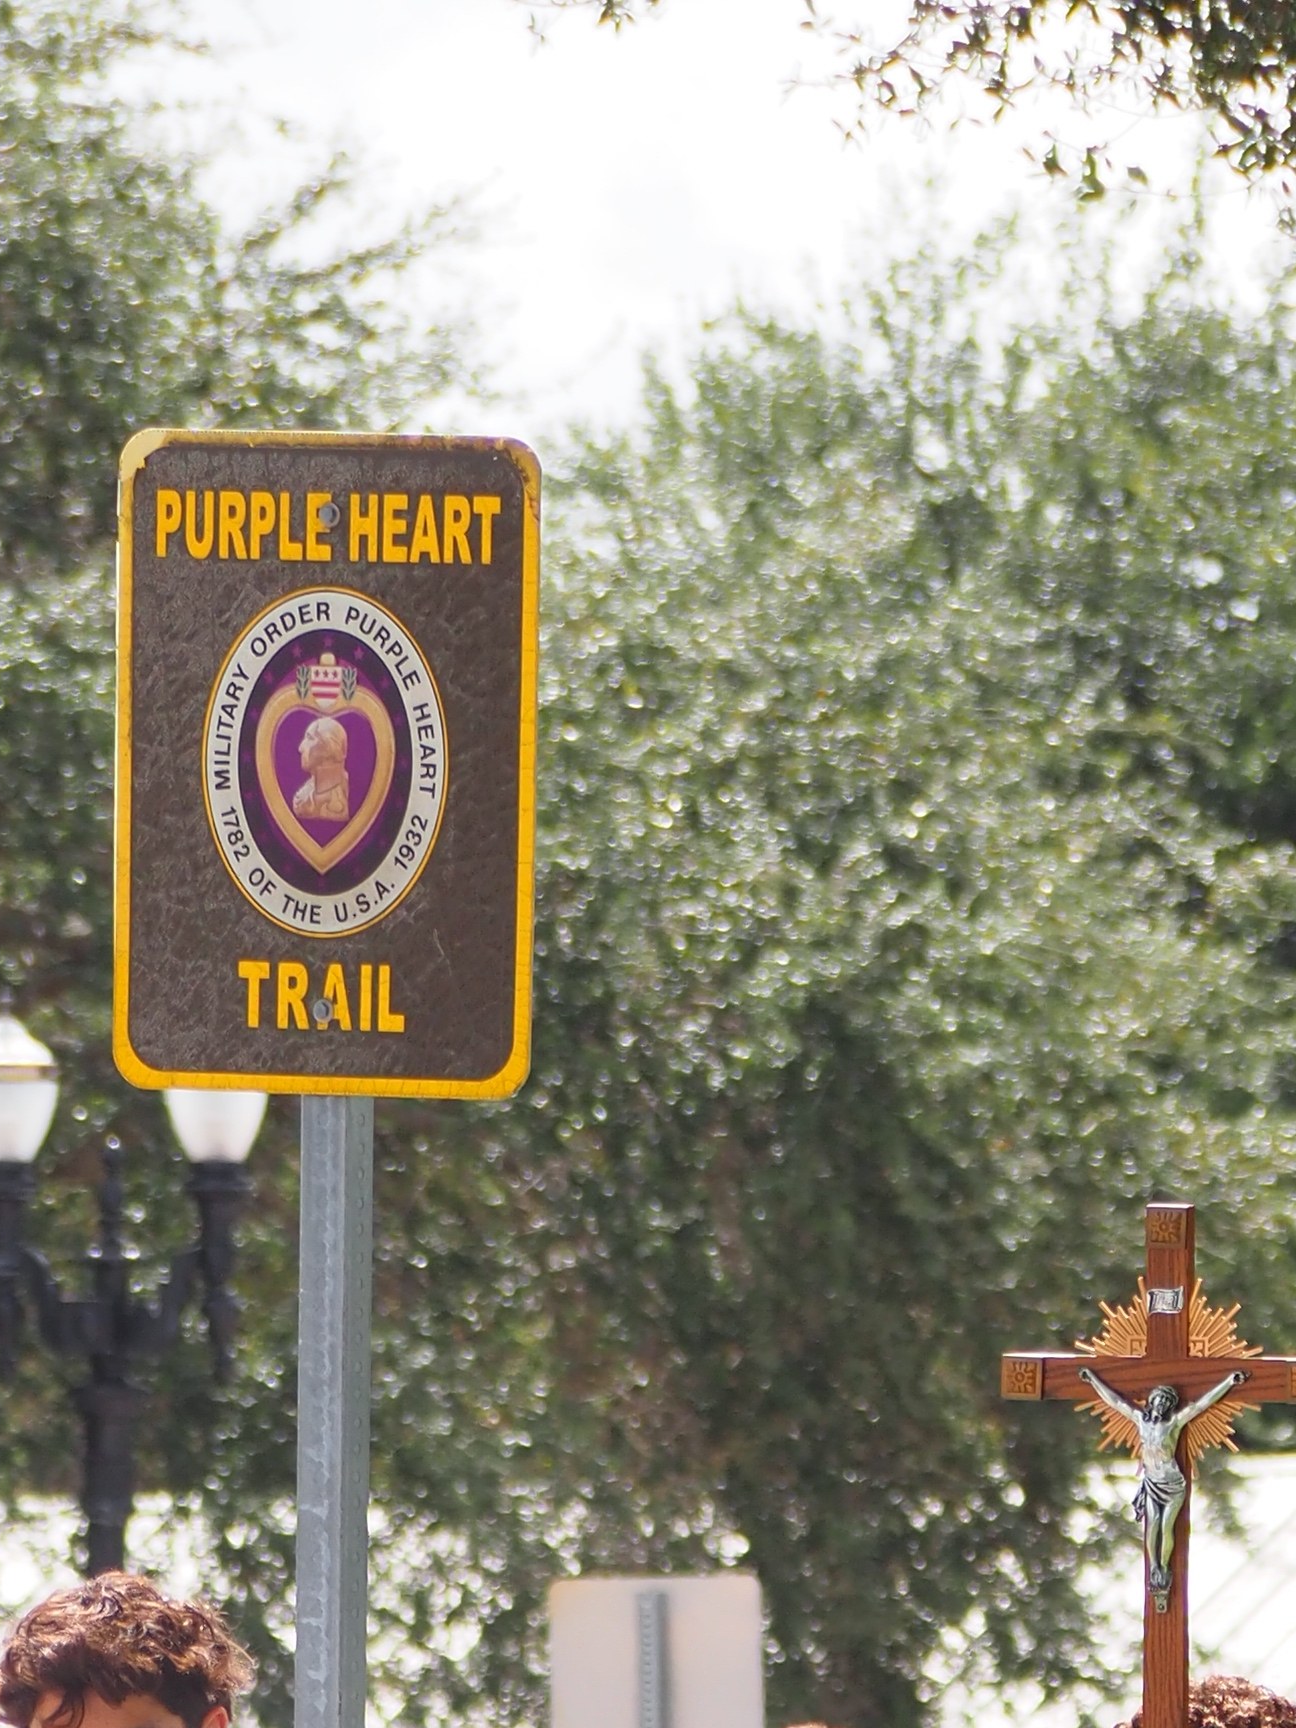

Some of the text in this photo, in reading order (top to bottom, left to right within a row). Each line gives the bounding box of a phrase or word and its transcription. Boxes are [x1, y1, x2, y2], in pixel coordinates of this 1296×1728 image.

[156, 489, 502, 565] PURPLE HEART
[214, 602, 437, 799] MILITARY ORDER PURPLE HEART
[221, 806, 429, 925] 1782 OF THE U.S.A. 1932
[238, 961, 405, 1033] TRAIL
